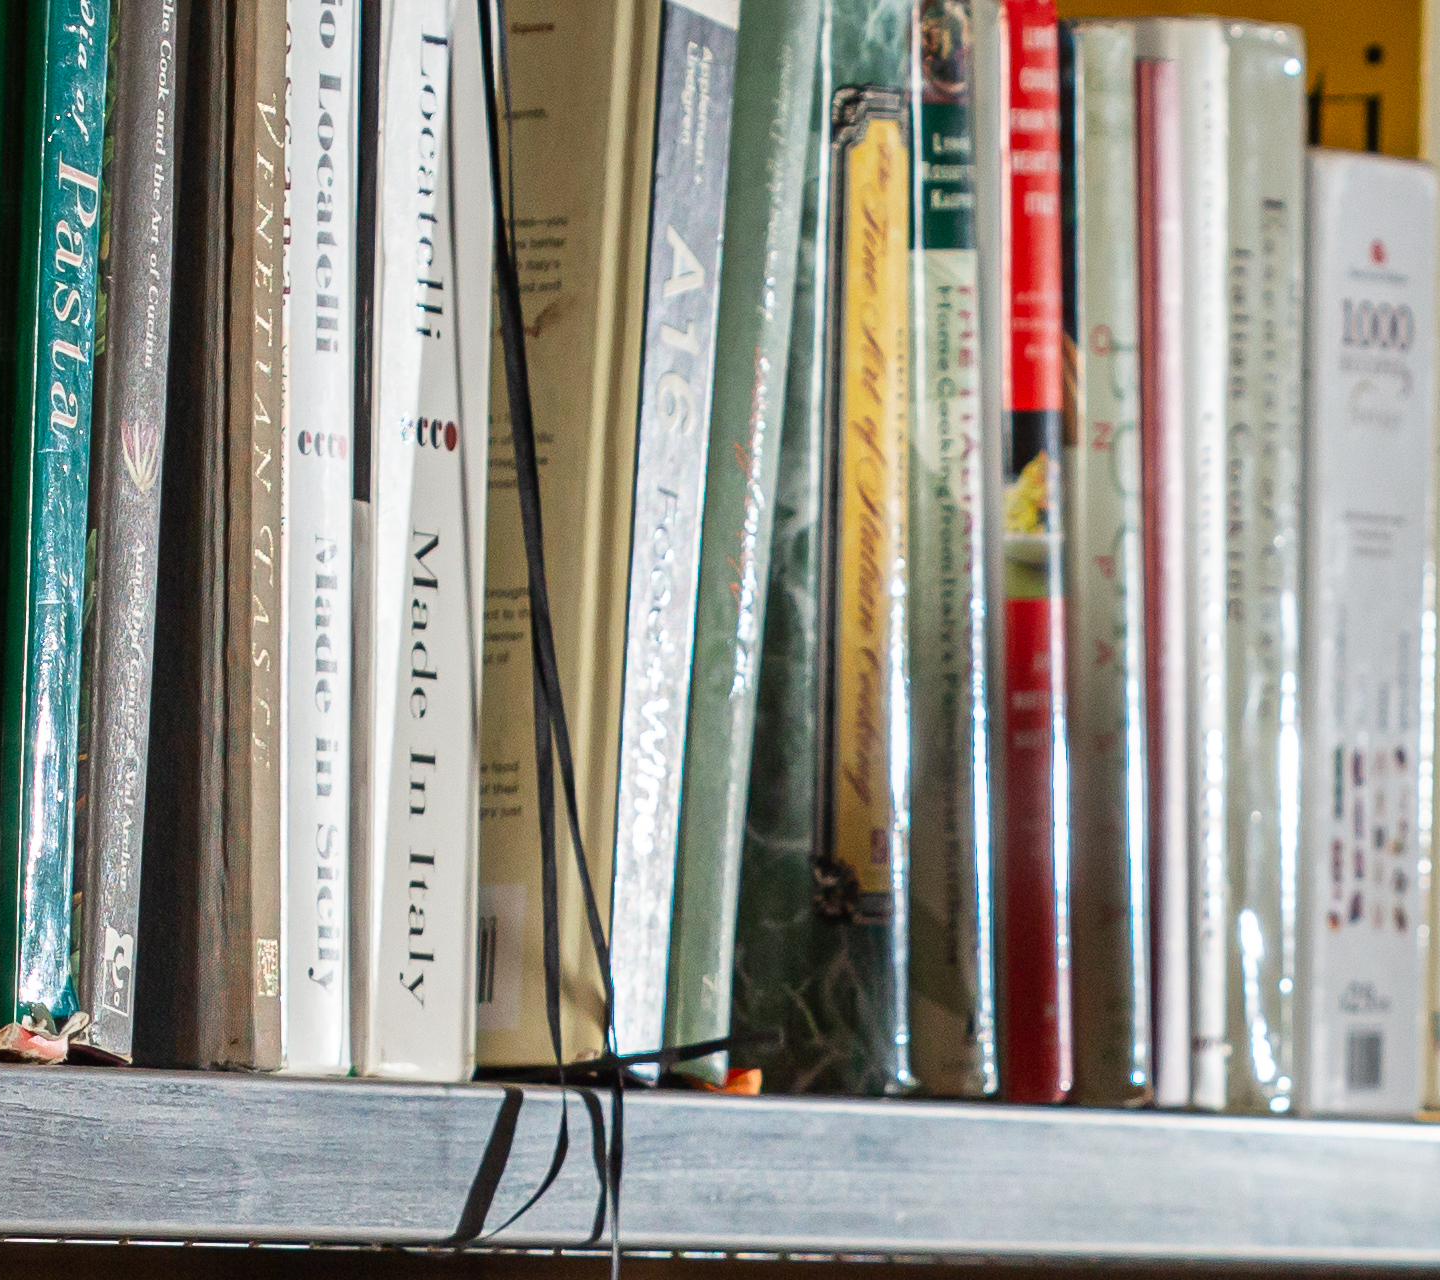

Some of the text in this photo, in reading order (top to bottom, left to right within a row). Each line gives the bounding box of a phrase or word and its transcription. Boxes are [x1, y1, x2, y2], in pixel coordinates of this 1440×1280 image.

[49, 151, 100, 438] Pasta
[148, 39, 174, 281] Cook and the Art of
[254, 93, 285, 493] VENETIAN
[314, 70, 340, 353] Locatelli
[413, 26, 449, 343] Locatelli
[656, 223, 705, 438] A16
[934, 376, 956, 499] Cooking
[1341, 298, 1416, 352] 1000
[307, 533, 341, 998] Made in Sicily
[399, 528, 441, 1010] Made In Italy
